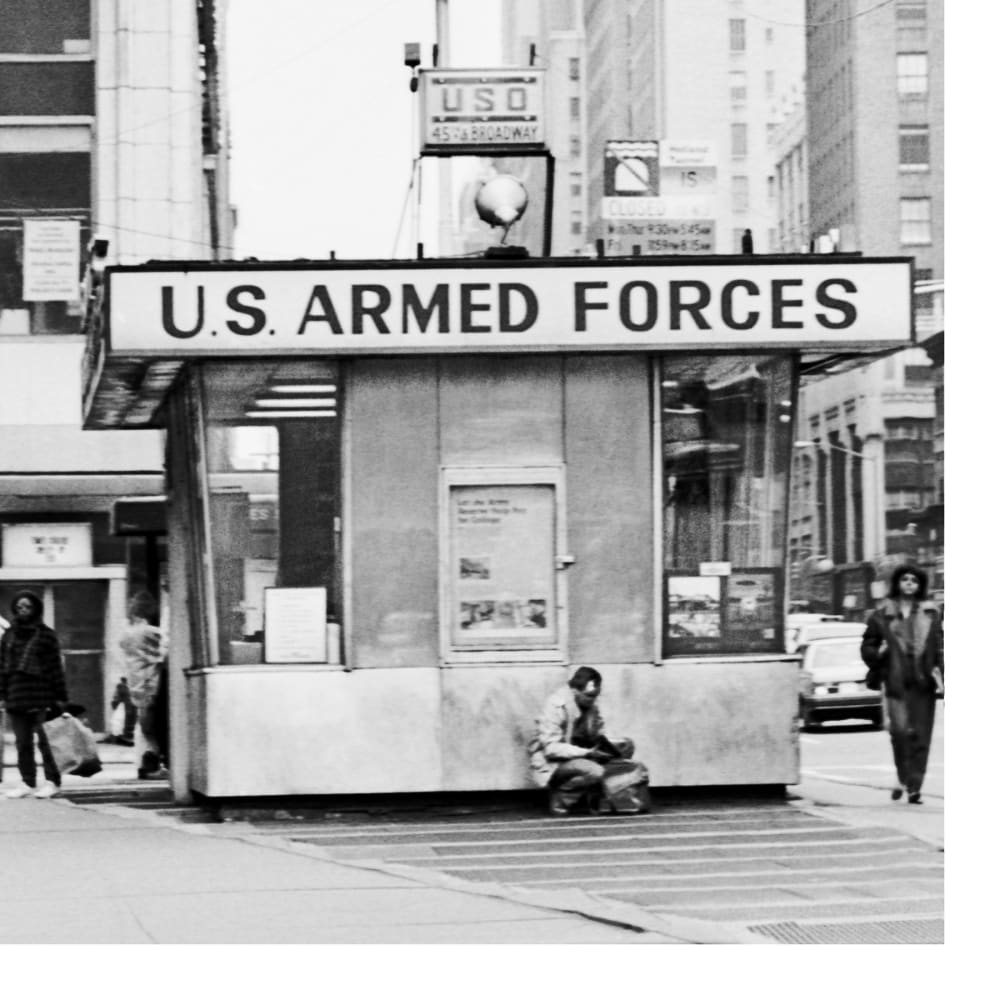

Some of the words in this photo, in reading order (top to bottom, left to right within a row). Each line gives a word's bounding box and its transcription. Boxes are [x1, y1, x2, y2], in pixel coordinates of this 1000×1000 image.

[442, 87, 527, 112] USO
[471, 125, 538, 140] BROADWAY
[160, 284, 276, 339] U.S.
[297, 281, 540, 336] ARMED
[573, 277, 859, 333] FORCES
